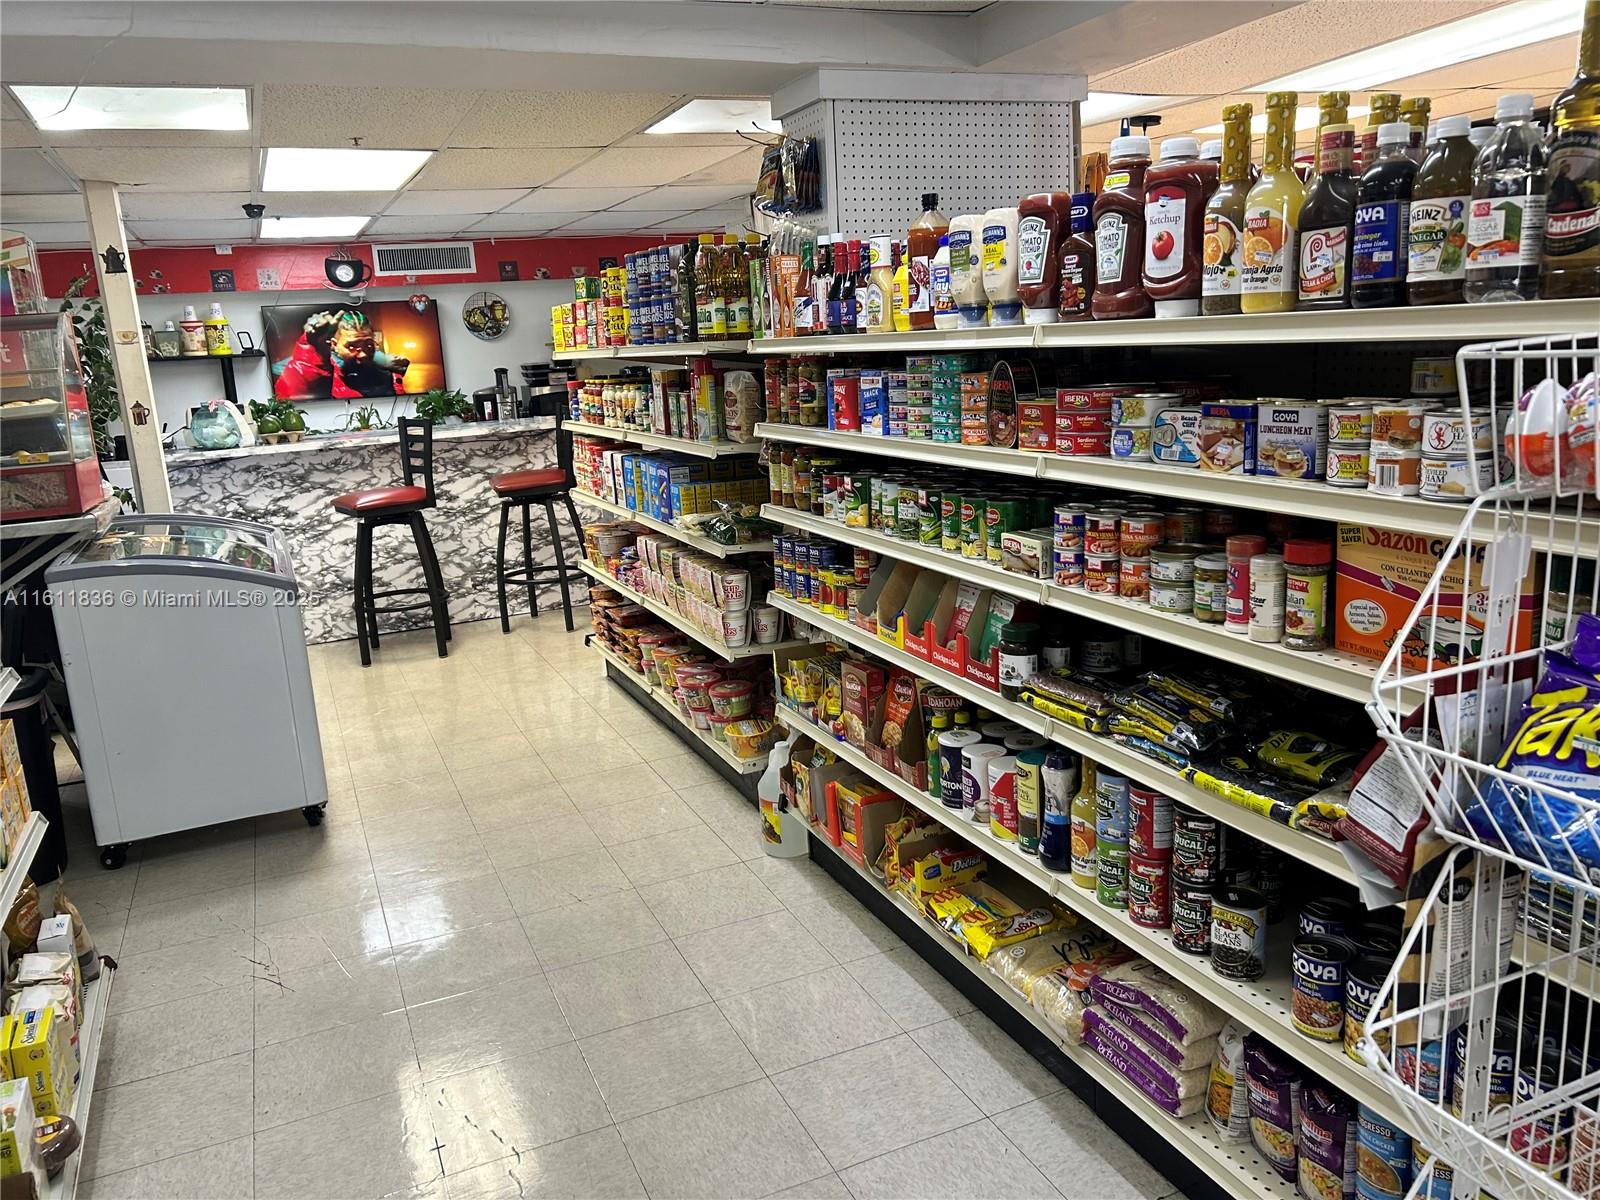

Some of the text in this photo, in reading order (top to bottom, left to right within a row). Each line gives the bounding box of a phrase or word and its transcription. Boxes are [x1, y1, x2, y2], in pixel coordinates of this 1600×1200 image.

[1149, 213, 1180, 225] Ketchup
[1355, 207, 1385, 223] OYA
[1411, 209, 1440, 223] HEINZ
[1022, 223, 1038, 234] HEINZ
[1242, 264, 1283, 277] ranja Agria
[863, 389, 879, 399] SNACK
[1064, 391, 1114, 404] IBERIA Sardines
[1076, 415, 1097, 423] Sardines
[1274, 411, 1298, 422] GOYA
[1373, 415, 1392, 426] OAST
[1259, 424, 1313, 436] LUNCHEON MEAT
[1450, 426, 1481, 434] DEVED
[1340, 527, 1361, 536] SUPER
[1342, 535, 1362, 543] SAVER
[1381, 563, 1473, 588] CON CULANTRO ACHIOE
[1287, 577, 1308, 588] STNUT
[724, 590, 744, 600] OODLES
[1287, 593, 1304, 606] alian
[1350, 603, 1380, 614] Especial para
[1348, 611, 1381, 621] Arroces, Salsas,
[1350, 617, 1381, 629] Guisos, Sopas,
[1546, 623, 1561, 639] DIA
[905, 639, 919, 651] Chicken
[933, 651, 949, 664] Chicken
[967, 664, 983, 678] Chicken
[927, 696, 963, 709] IDAHOAN
[1497, 685, 1600, 774] Tak
[1525, 769, 1582, 784] BLUE HEAT
[941, 780, 962, 792] ORTON
[1174, 832, 1204, 850] DUCAL
[1177, 849, 1197, 860] NEGROS
[1098, 861, 1124, 877] DUCAL
[1174, 904, 1203, 920] DUCAL
[1013, 921, 1037, 934] Vigo
[1177, 920, 1197, 930] NEGROS
[1300, 912, 1326, 934] OYA
[1214, 926, 1241, 941] BLACK
[1214, 936, 1243, 948] BEANS
[1292, 951, 1338, 981] GOYA
[1299, 978, 1319, 991] Lentils
[1106, 982, 1135, 1002] RICELAND
[1103, 998, 1133, 1027] RICELAND
[1098, 1022, 1129, 1052] RICELAND
[1096, 1041, 1128, 1073] RICELAND
[1252, 1101, 1279, 1116] asmine
[1302, 1116, 1334, 1140] hatma
[1302, 1134, 1330, 1158] smine
